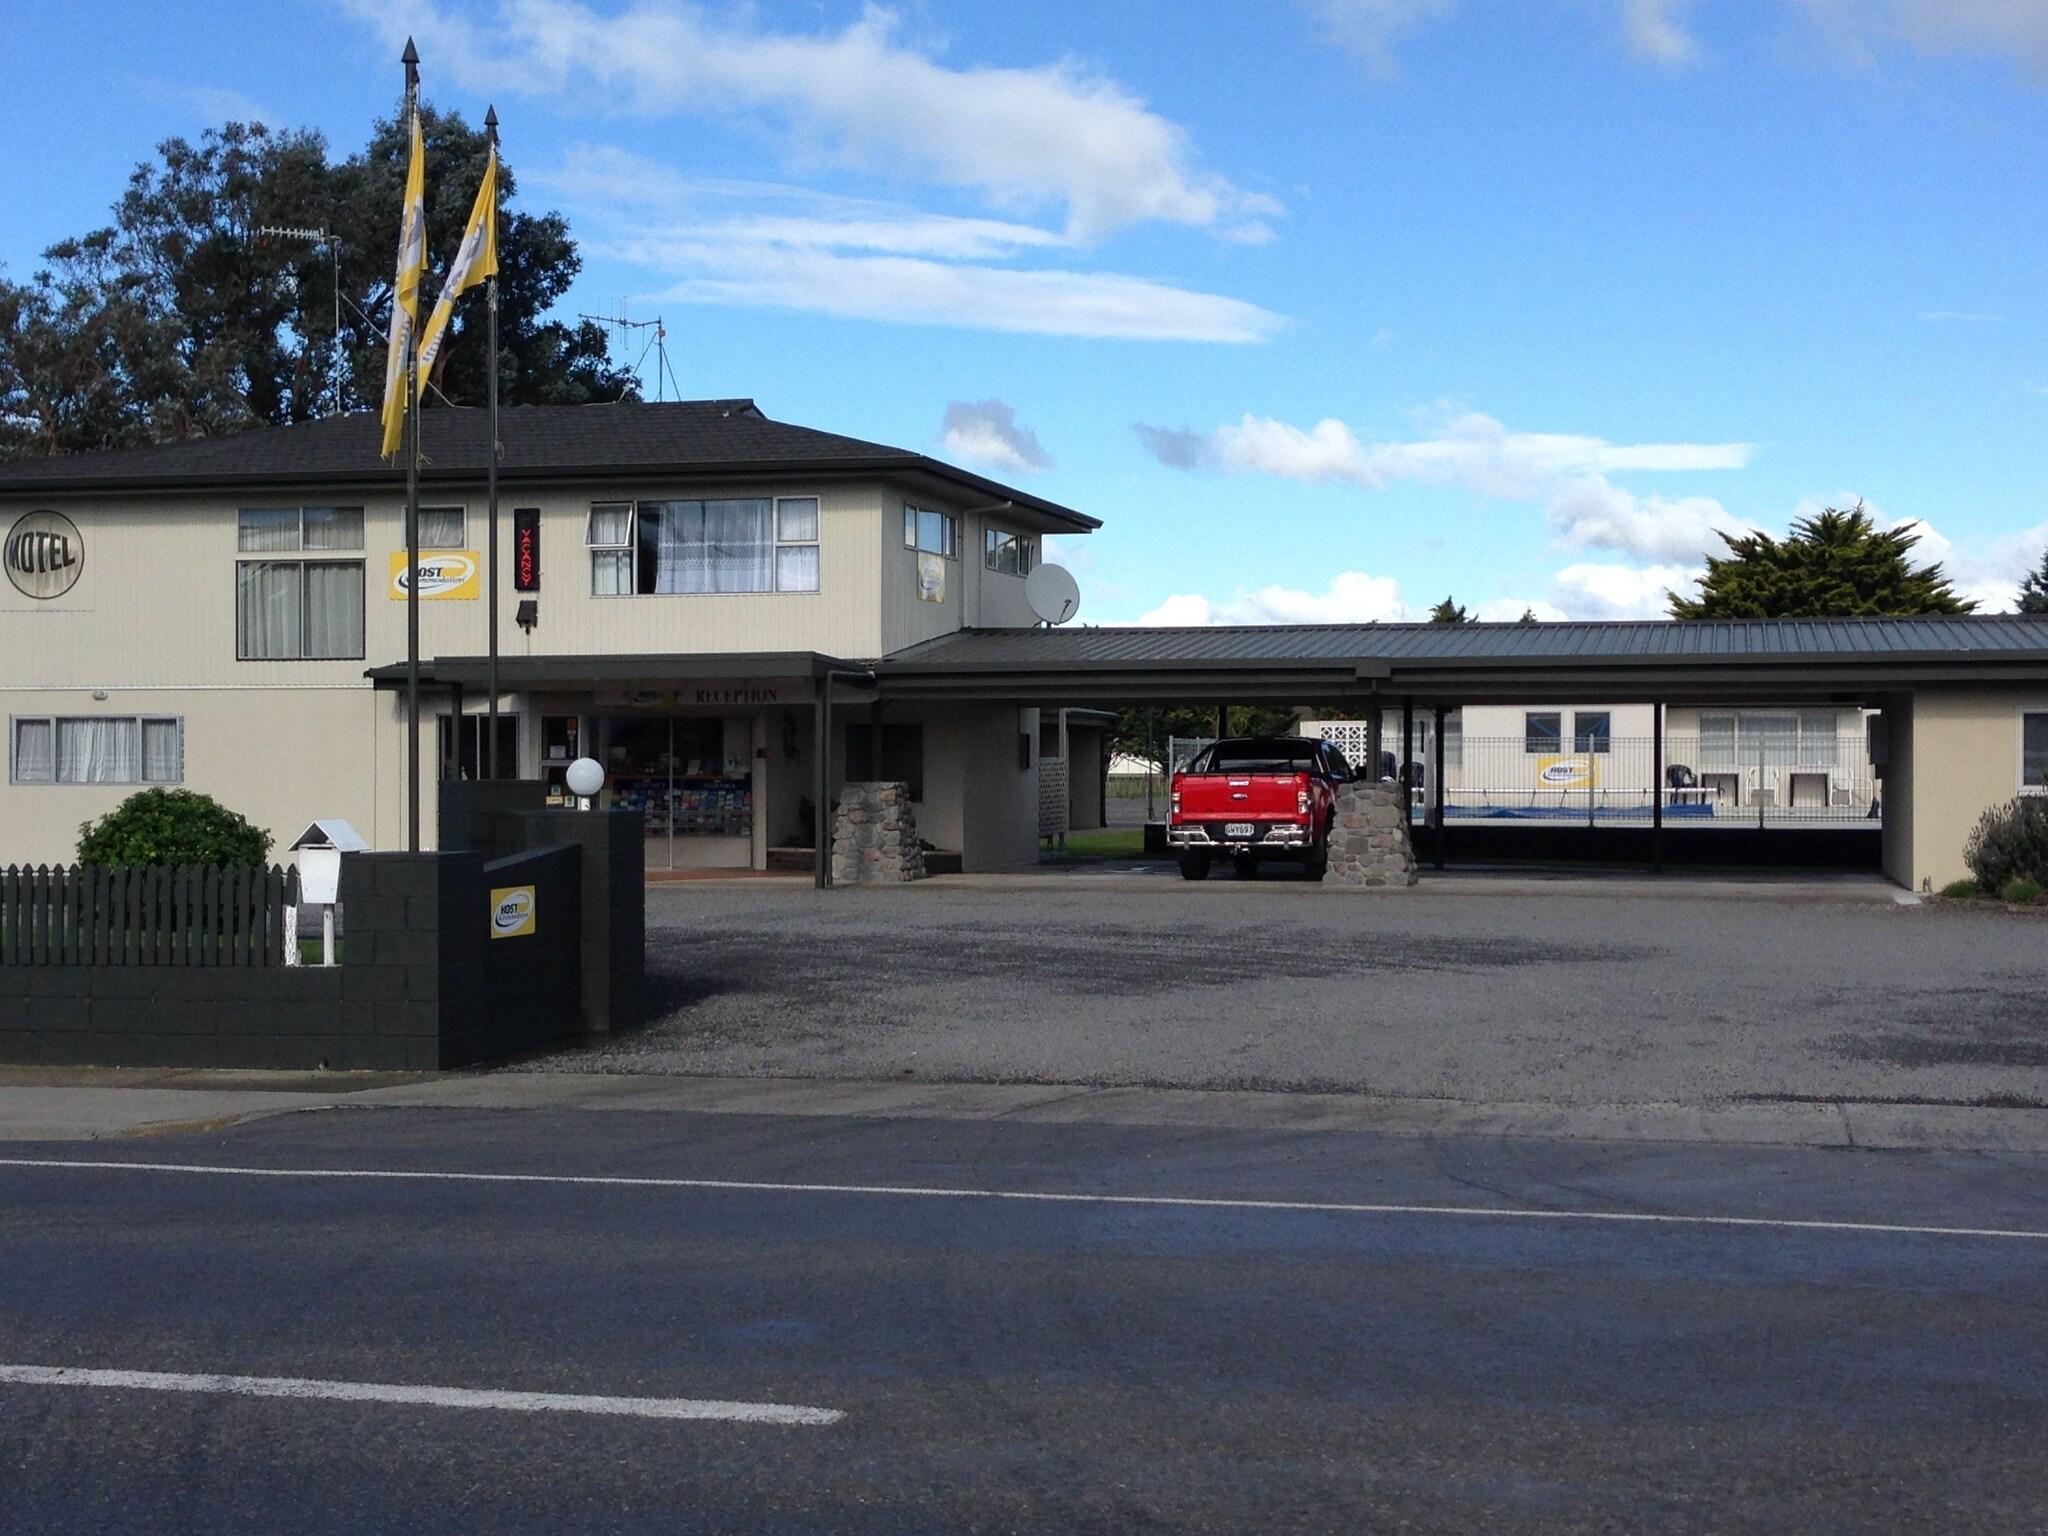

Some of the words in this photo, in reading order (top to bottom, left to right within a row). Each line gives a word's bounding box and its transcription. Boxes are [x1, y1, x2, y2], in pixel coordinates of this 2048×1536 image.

[8, 531, 76, 574] MOTEL
[521, 528, 532, 586] VACANCY
[418, 567, 444, 577] OST
[696, 688, 777, 703] RECEPTION
[500, 903, 518, 914] HOST
